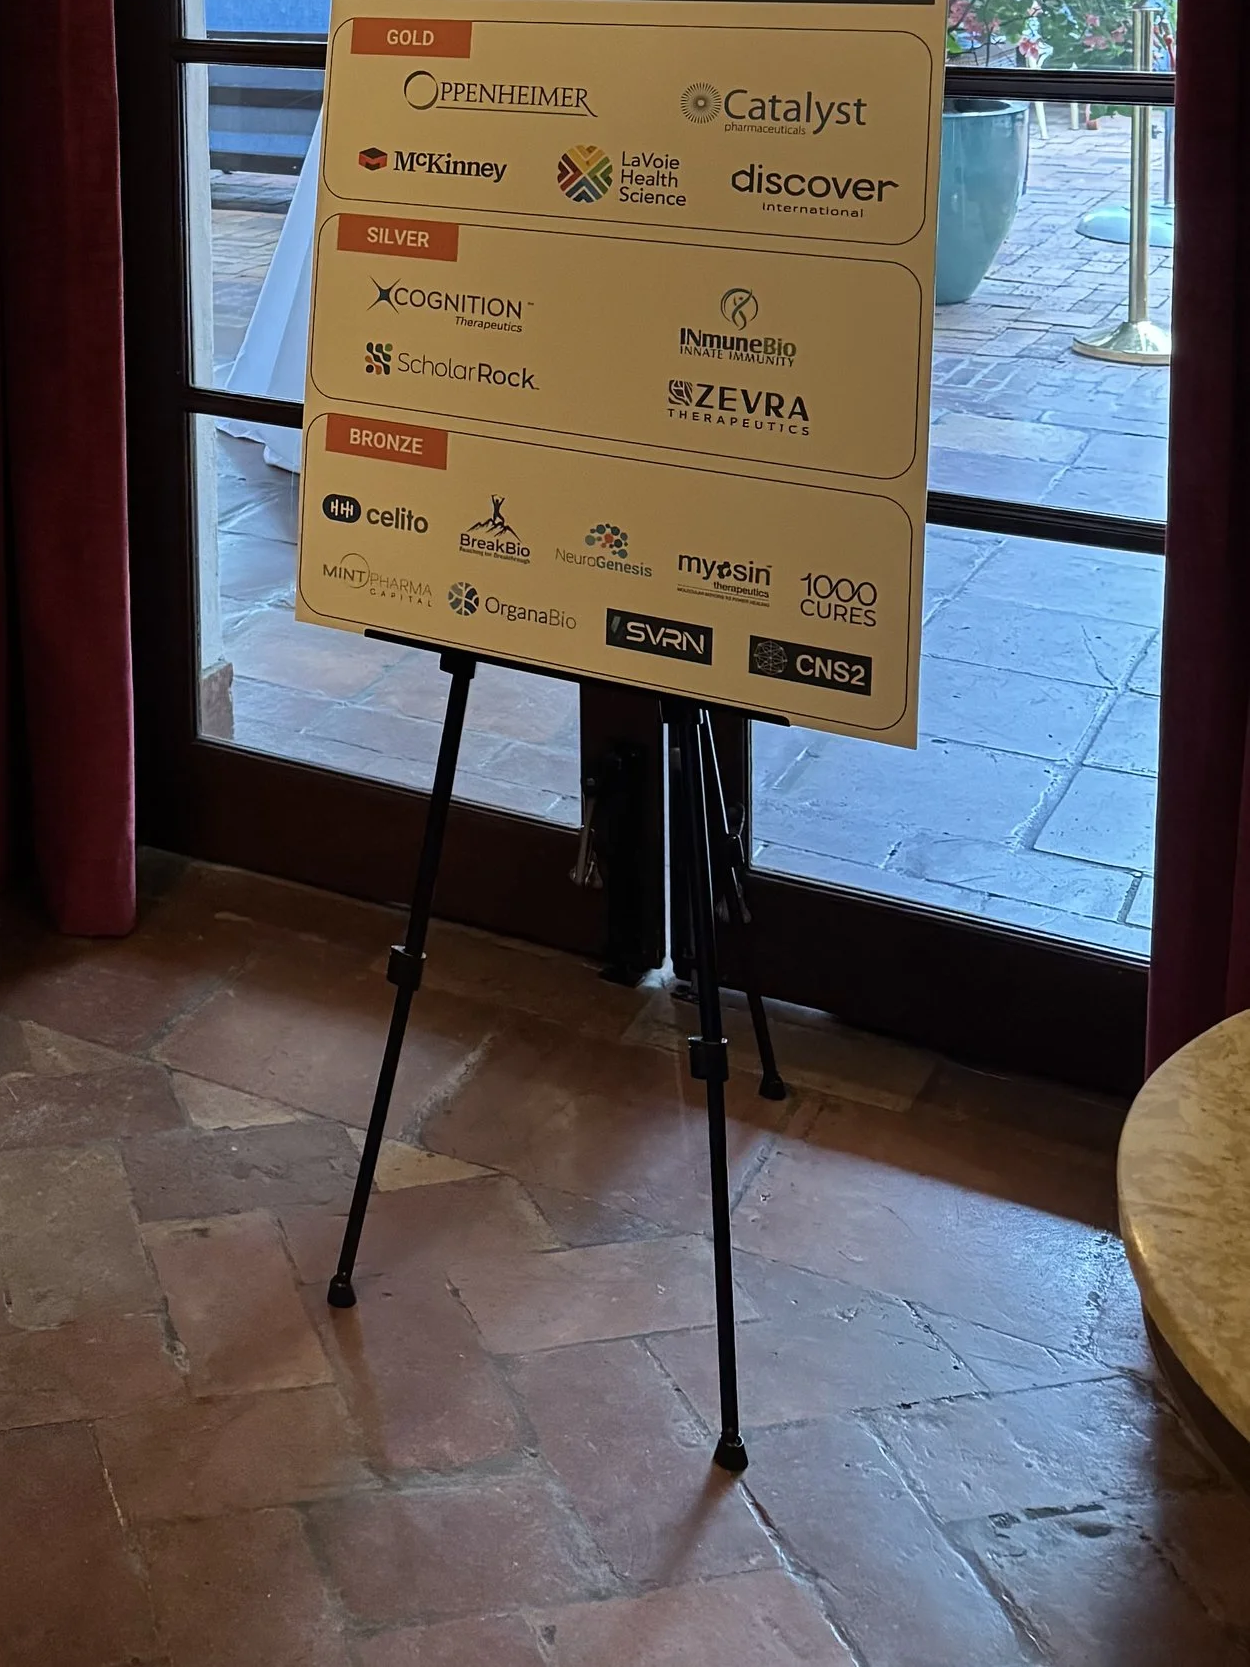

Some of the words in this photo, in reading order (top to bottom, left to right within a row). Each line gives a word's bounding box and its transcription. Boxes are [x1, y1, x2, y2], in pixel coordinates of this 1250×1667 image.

[386, 29, 435, 46] GOLD
[404, 70, 598, 117] OPPENHEIMER
[723, 89, 868, 135] Catalyst
[724, 122, 806, 136] pharmaceuticals
[393, 151, 507, 183] McKinney
[621, 151, 680, 170] LaVoie
[620, 169, 678, 188] Health
[731, 164, 899, 202] discover
[619, 186, 687, 207] Science
[762, 202, 864, 219] international
[366, 226, 430, 248] SILVER
[394, 287, 522, 320] COGNITION
[455, 316, 523, 333] Therapeutics
[680, 327, 797, 357] INmuneBio
[680, 345, 723, 360] INNATE
[729, 352, 795, 368] IMMUNITY
[695, 383, 810, 422] ZEVRA
[667, 408, 810, 436] THERAPEUTICS
[350, 427, 424, 455] BRONZE
[366, 507, 429, 534] celito
[460, 533, 530, 557] BreakBio
[555, 547, 652, 577] NeuroGenesis
[369, 587, 433, 608] CAPITAL
[713, 581, 770, 598] therapeutics
[800, 573, 877, 607] 1000
[485, 596, 577, 630] OrganaBio
[800, 599, 877, 627] CURES
[626, 621, 704, 655] SVRN
[796, 654, 866, 686] CNS2
